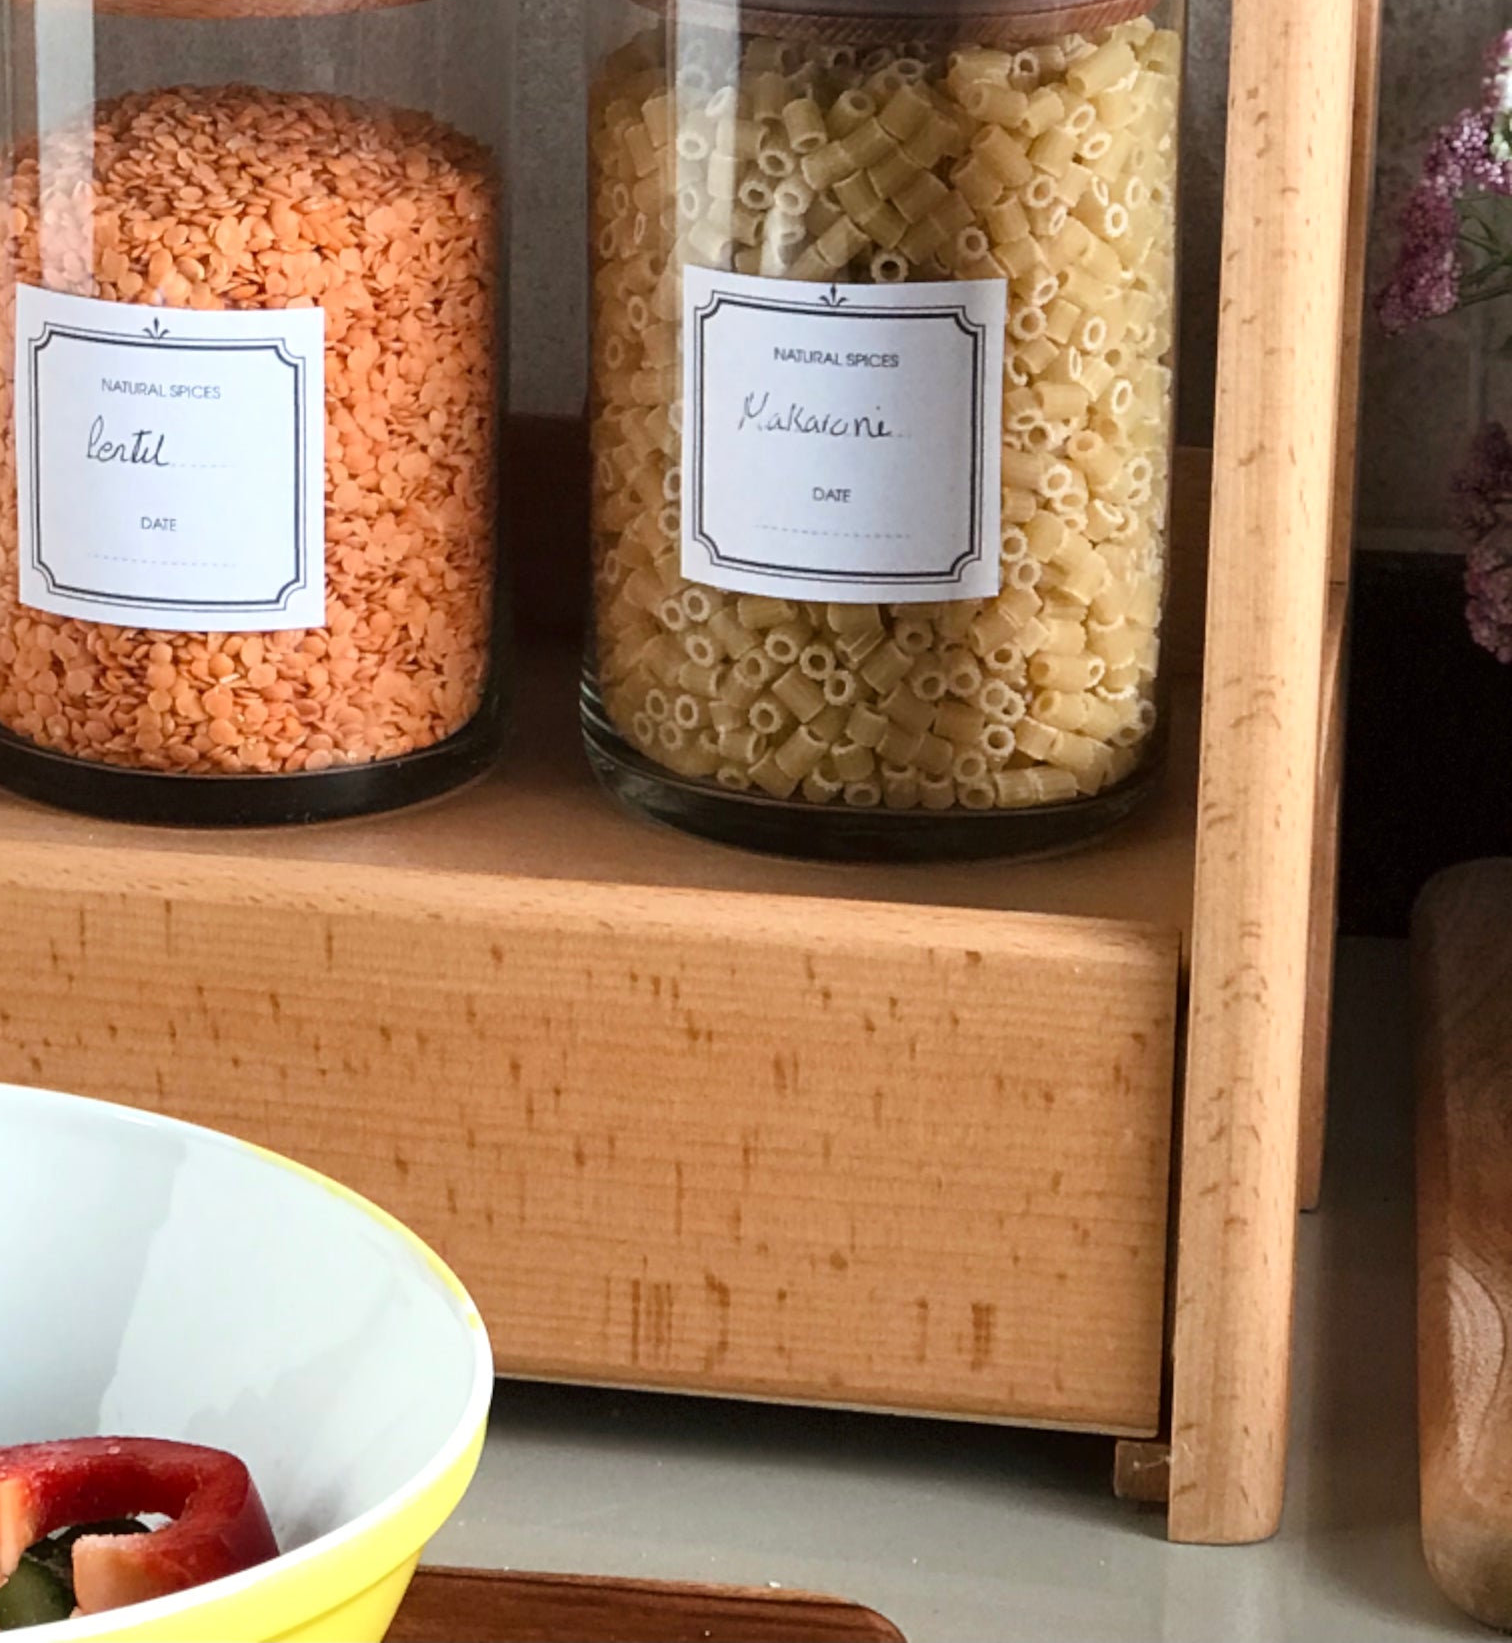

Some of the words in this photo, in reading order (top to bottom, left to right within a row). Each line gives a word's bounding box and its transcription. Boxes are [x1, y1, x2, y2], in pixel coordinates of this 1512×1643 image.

[773, 346, 841, 366] NATURAL
[845, 353, 900, 369] SPICES
[101, 377, 168, 398] NATURAL
[169, 384, 222, 400] SPICES
[811, 486, 852, 504] DATE
[140, 516, 178, 533] DATE
